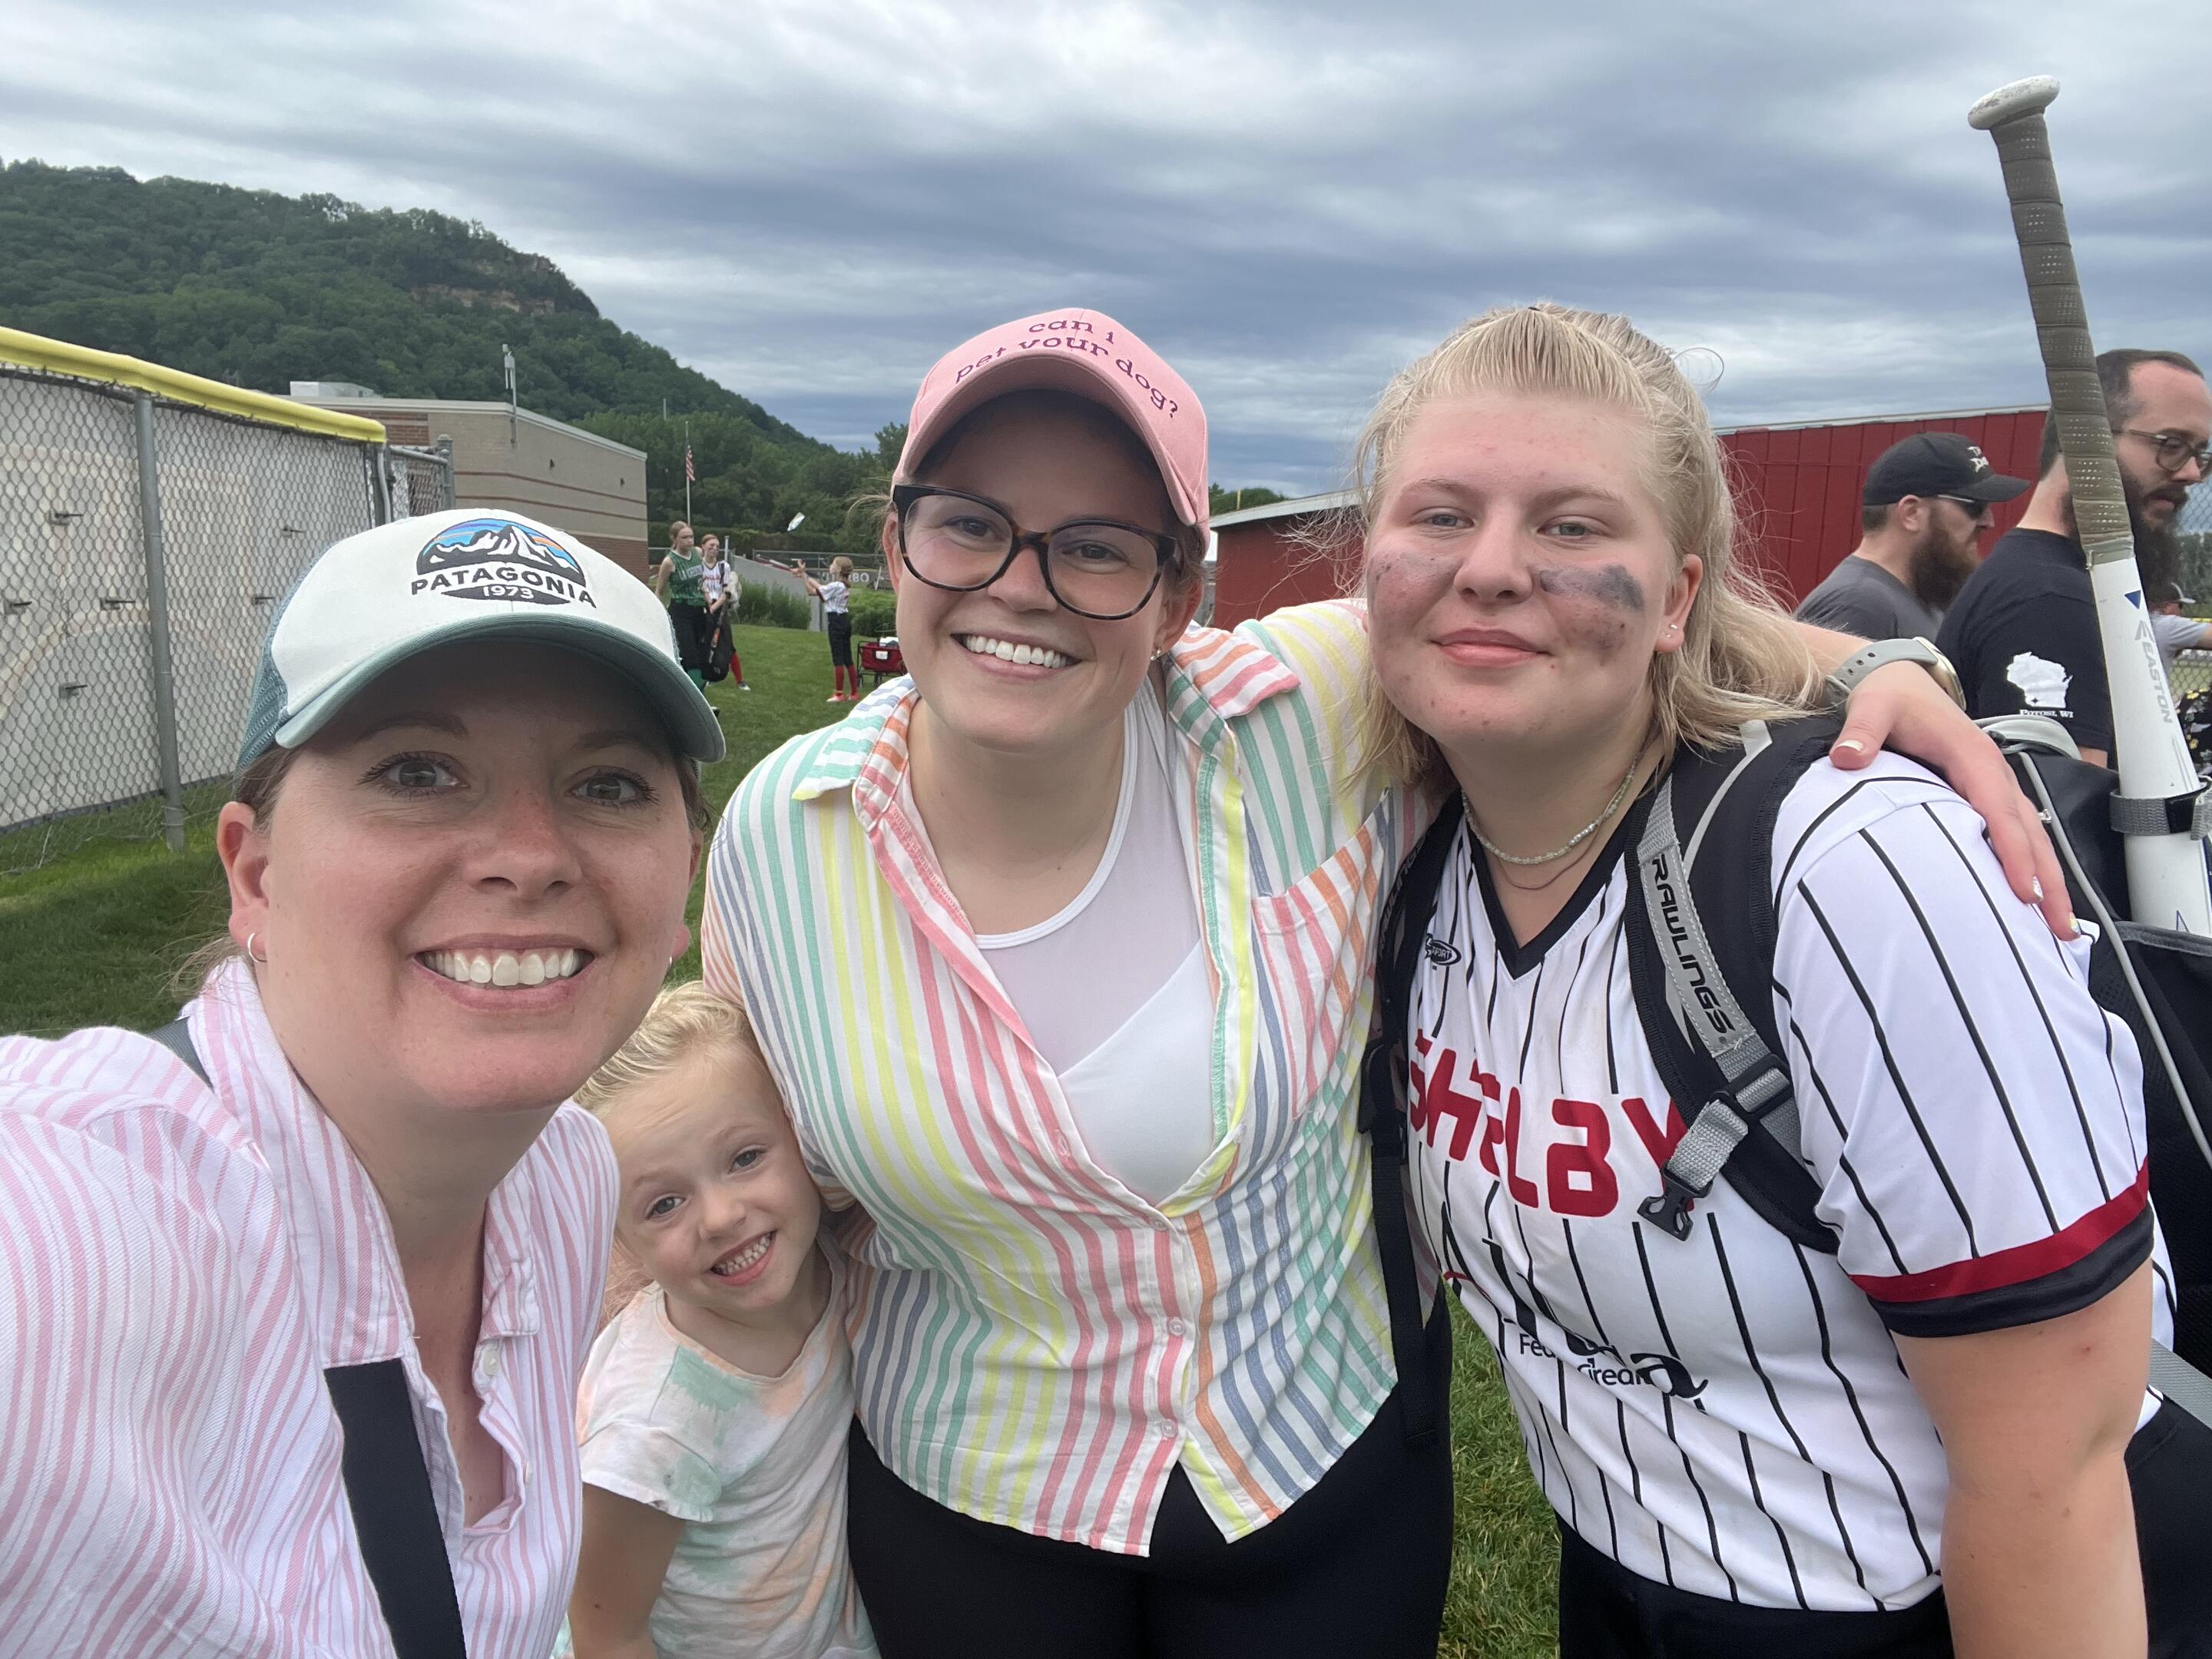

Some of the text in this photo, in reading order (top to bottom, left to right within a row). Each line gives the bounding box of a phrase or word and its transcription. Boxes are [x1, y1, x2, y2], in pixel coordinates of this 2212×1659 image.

[1028, 320, 1114, 344] can i
[955, 346, 1007, 384] pet
[1114, 359, 1179, 418] dog?
[411, 567, 597, 608] PATAGONIA
[483, 585, 535, 599] 1973
[2141, 641, 2173, 724] EASTON
[2059, 710, 2074, 718] WI
[1651, 853, 1736, 1034] RAWLINGS
